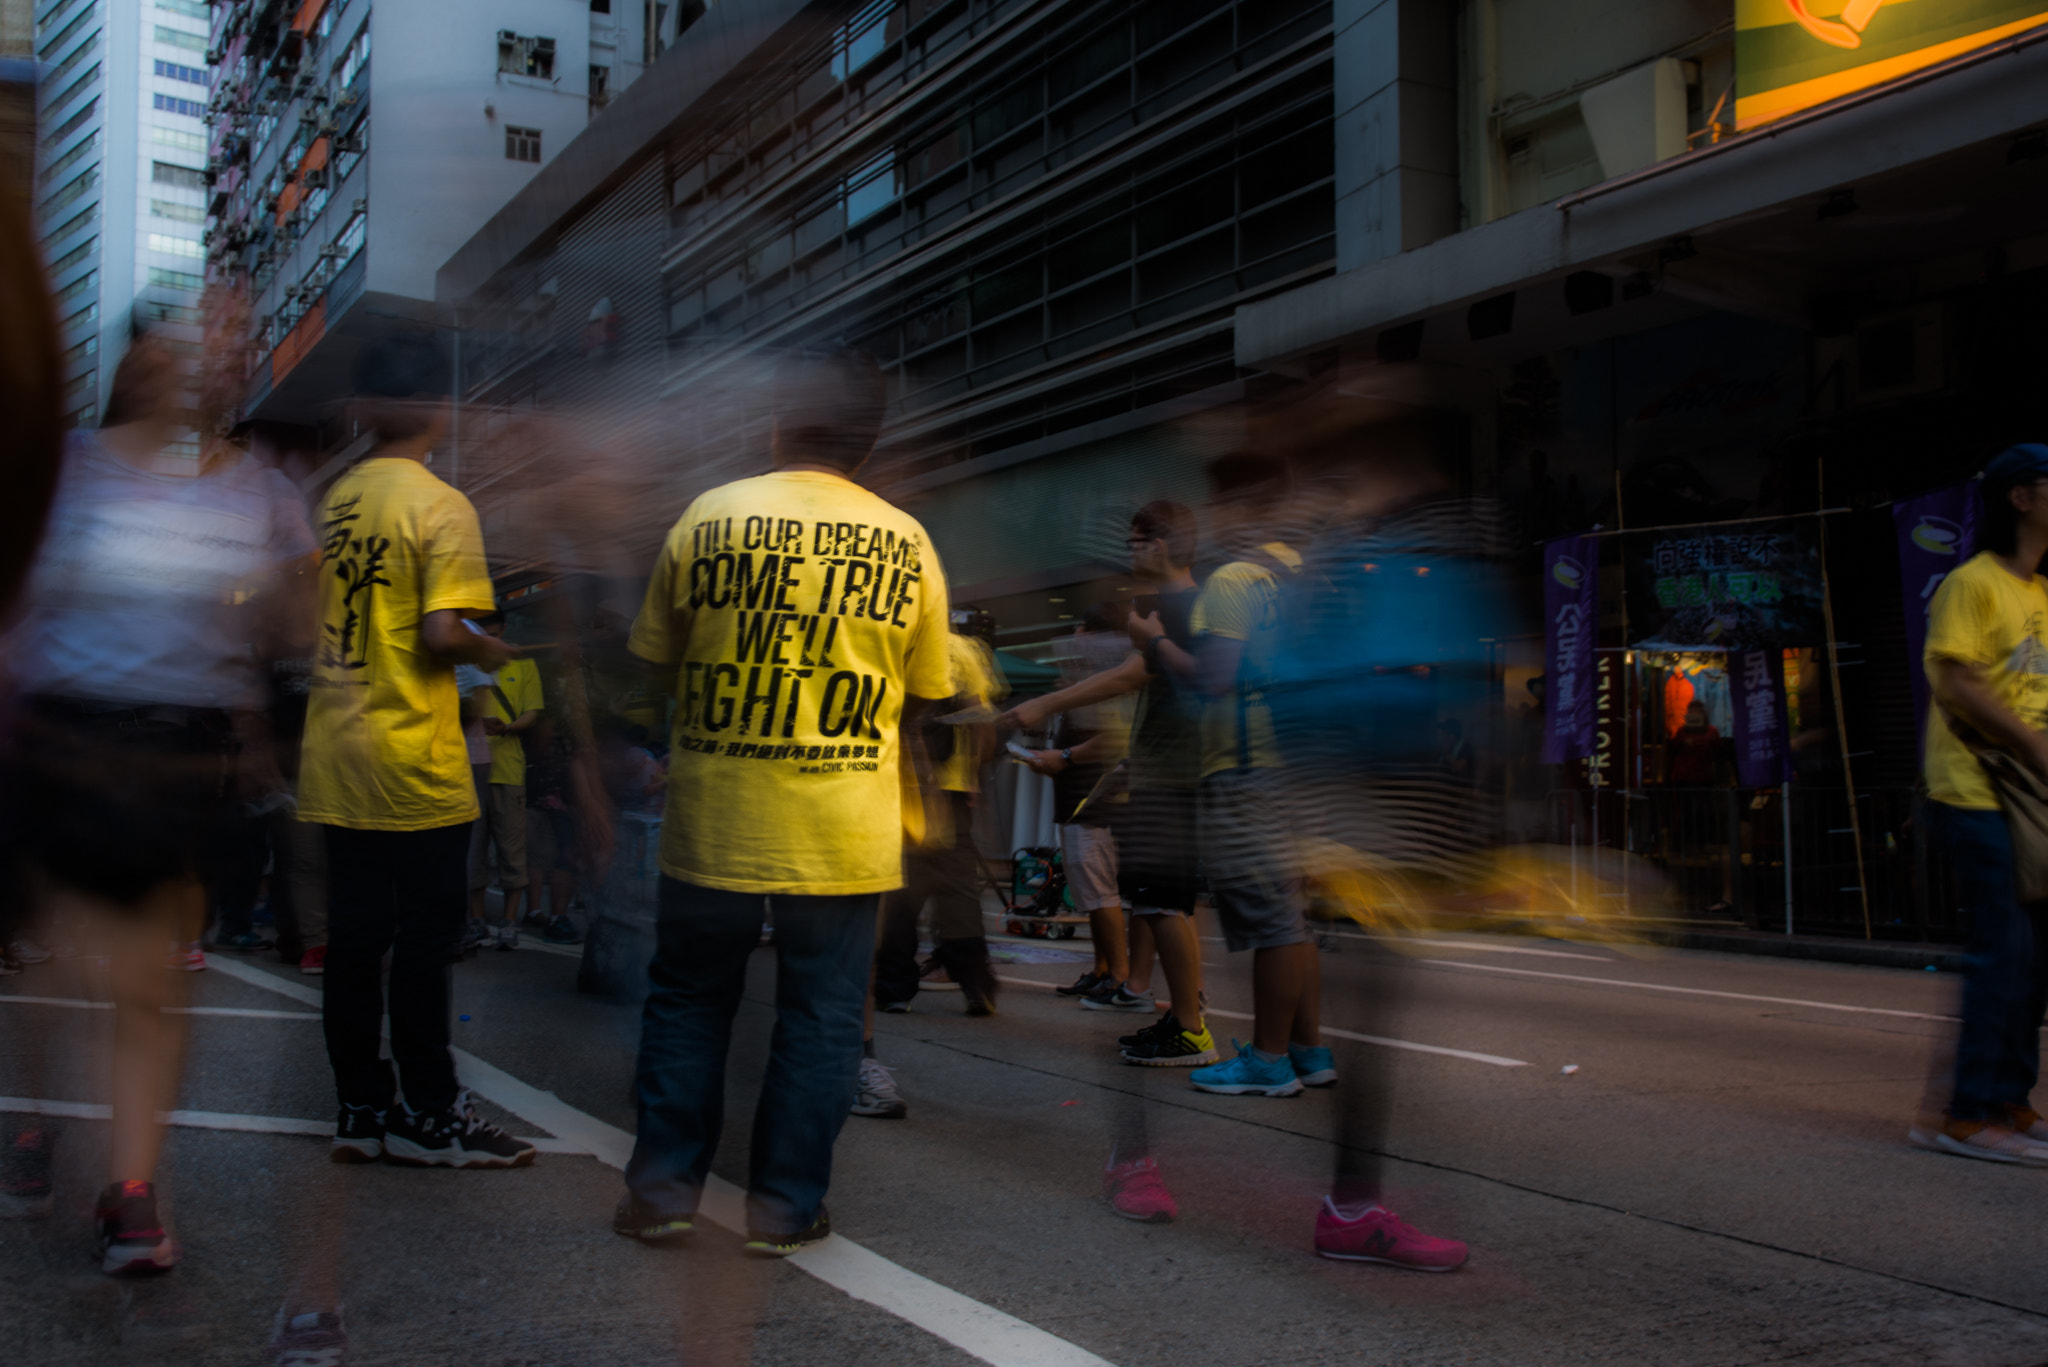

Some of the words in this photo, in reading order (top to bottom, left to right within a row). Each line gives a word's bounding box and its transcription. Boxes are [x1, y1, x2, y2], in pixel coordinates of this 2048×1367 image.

[690, 517, 734, 559] TILL
[744, 515, 804, 554] OUR
[813, 522, 924, 574] DREAMS
[689, 553, 805, 611] COME
[817, 558, 920, 629] TRUE
[1655, 573, 1783, 607] 香港人可以
[735, 611, 839, 668] WE'LL
[683, 661, 814, 738] FIGHT
[818, 670, 887, 739] ON
[1743, 651, 1779, 734] 民黨
